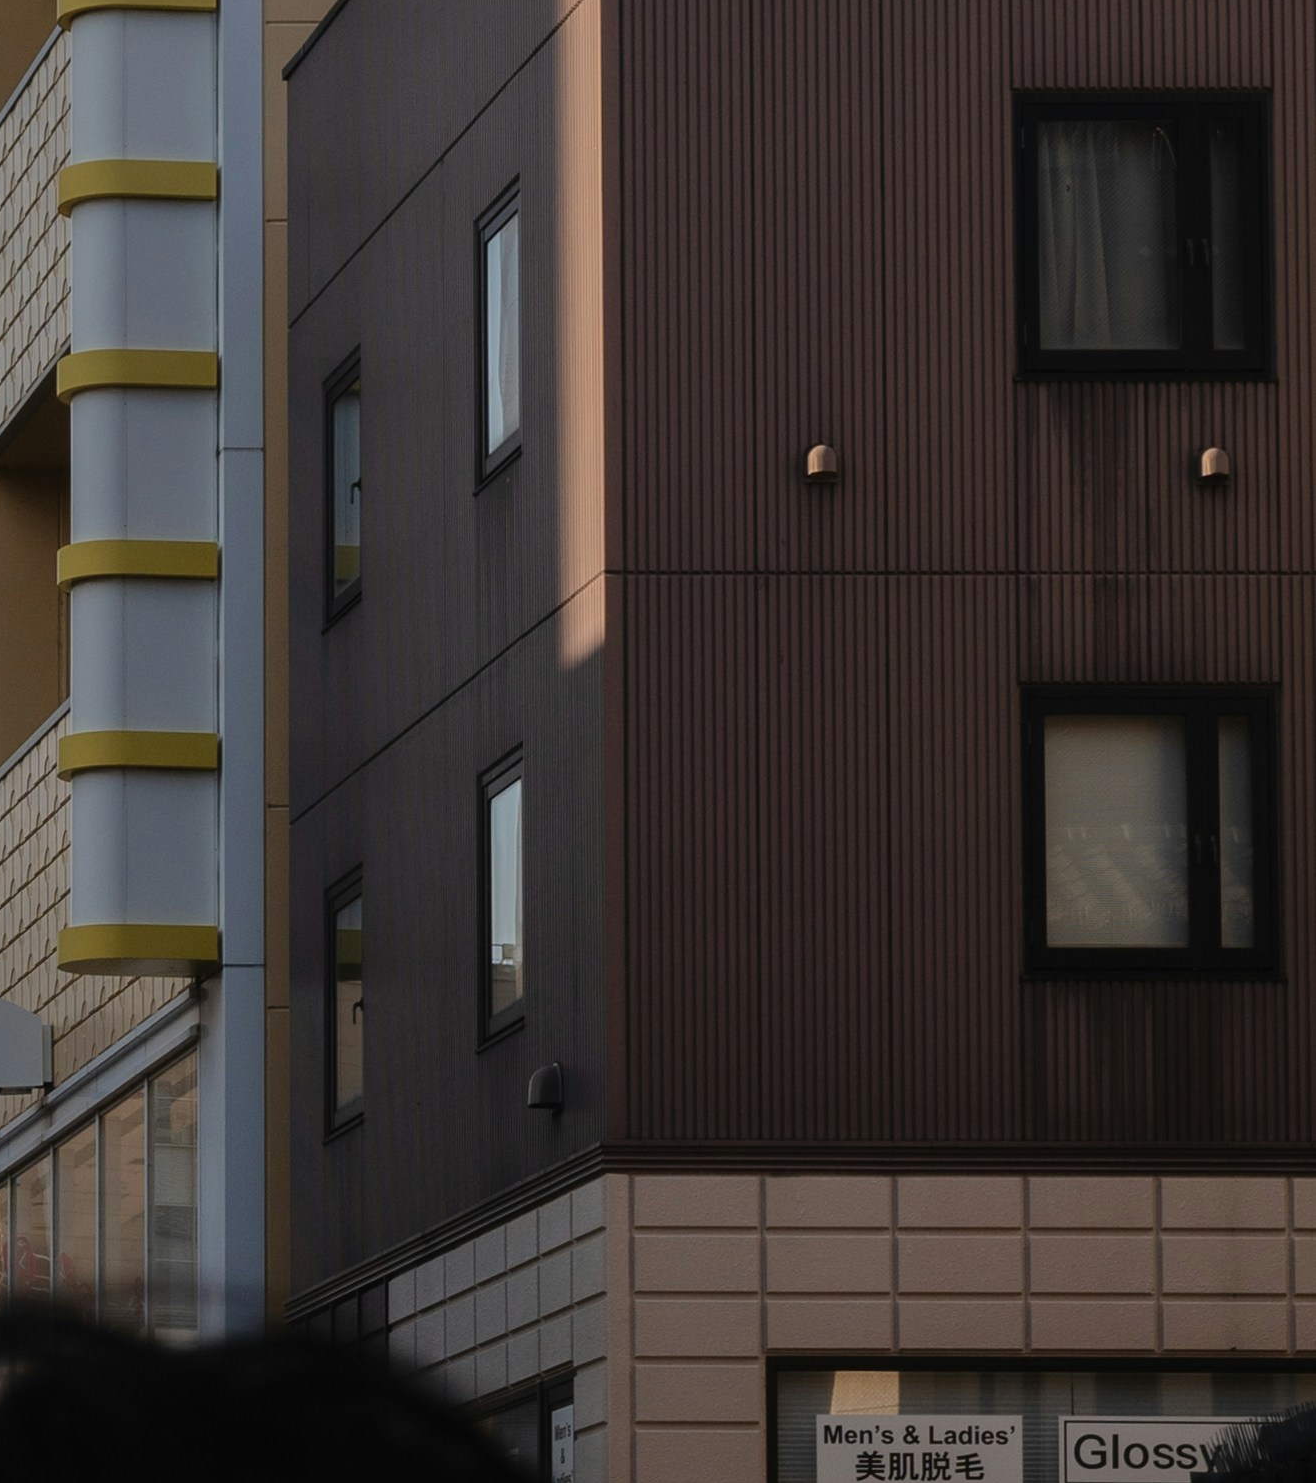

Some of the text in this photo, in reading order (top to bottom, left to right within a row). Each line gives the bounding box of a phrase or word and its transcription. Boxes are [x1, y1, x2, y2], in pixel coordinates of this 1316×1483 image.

[824, 1423, 1017, 1445] Men's & Ladies'
[855, 1451, 985, 1482] 美肌脱毛
